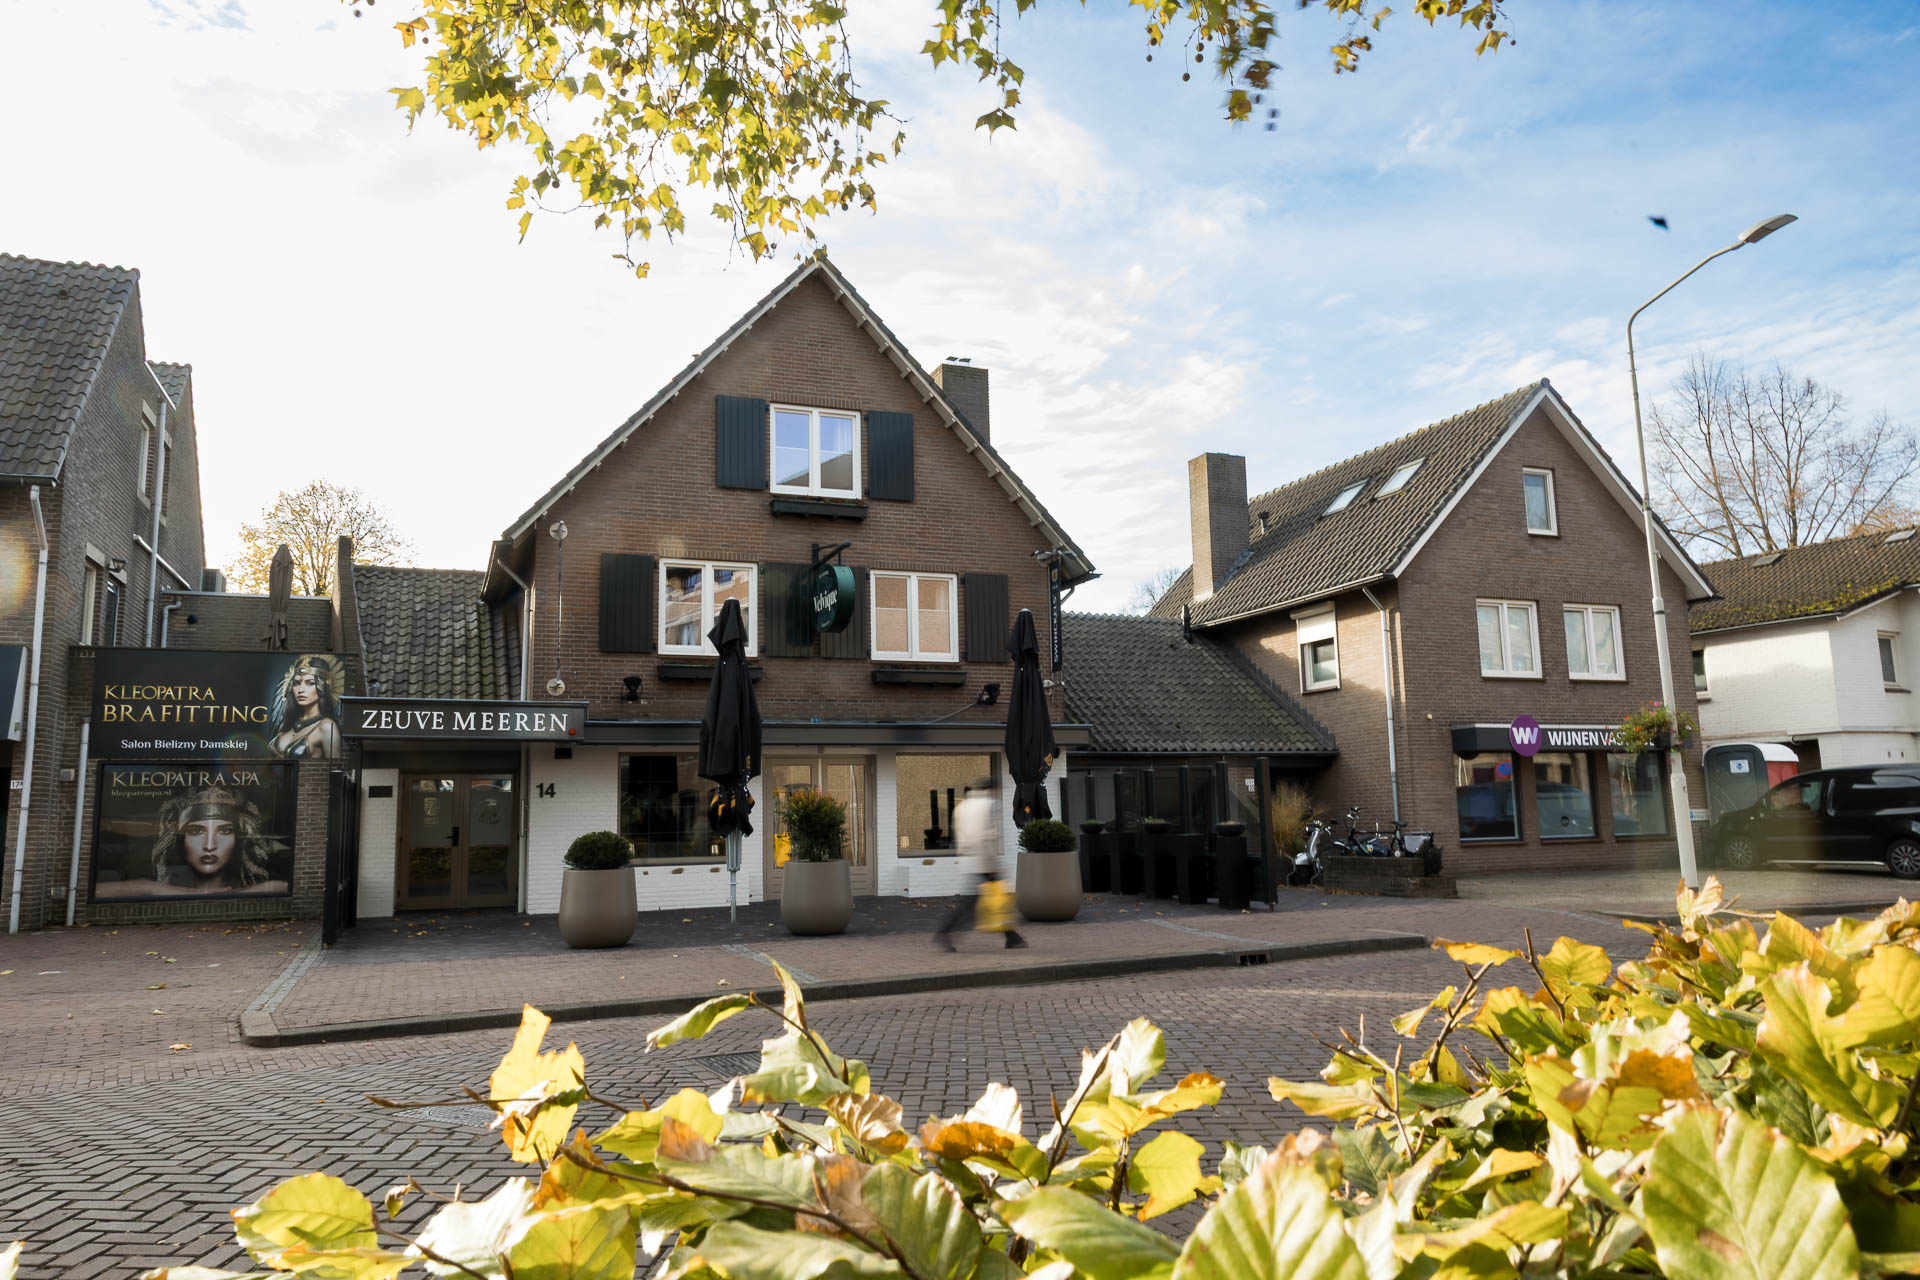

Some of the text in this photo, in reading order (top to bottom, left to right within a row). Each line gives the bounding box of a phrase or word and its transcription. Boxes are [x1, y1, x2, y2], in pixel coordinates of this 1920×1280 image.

[104, 685, 216, 700] KLEOPATRA
[361, 709, 569, 732] ZEUVE MEEREN
[121, 739, 248, 751] Salon Bielizny Damskiej
[1548, 731, 1599, 746] WIJNEN
[112, 771, 261, 787] KLEOPATRA SPA
[535, 782, 557, 798] 14
